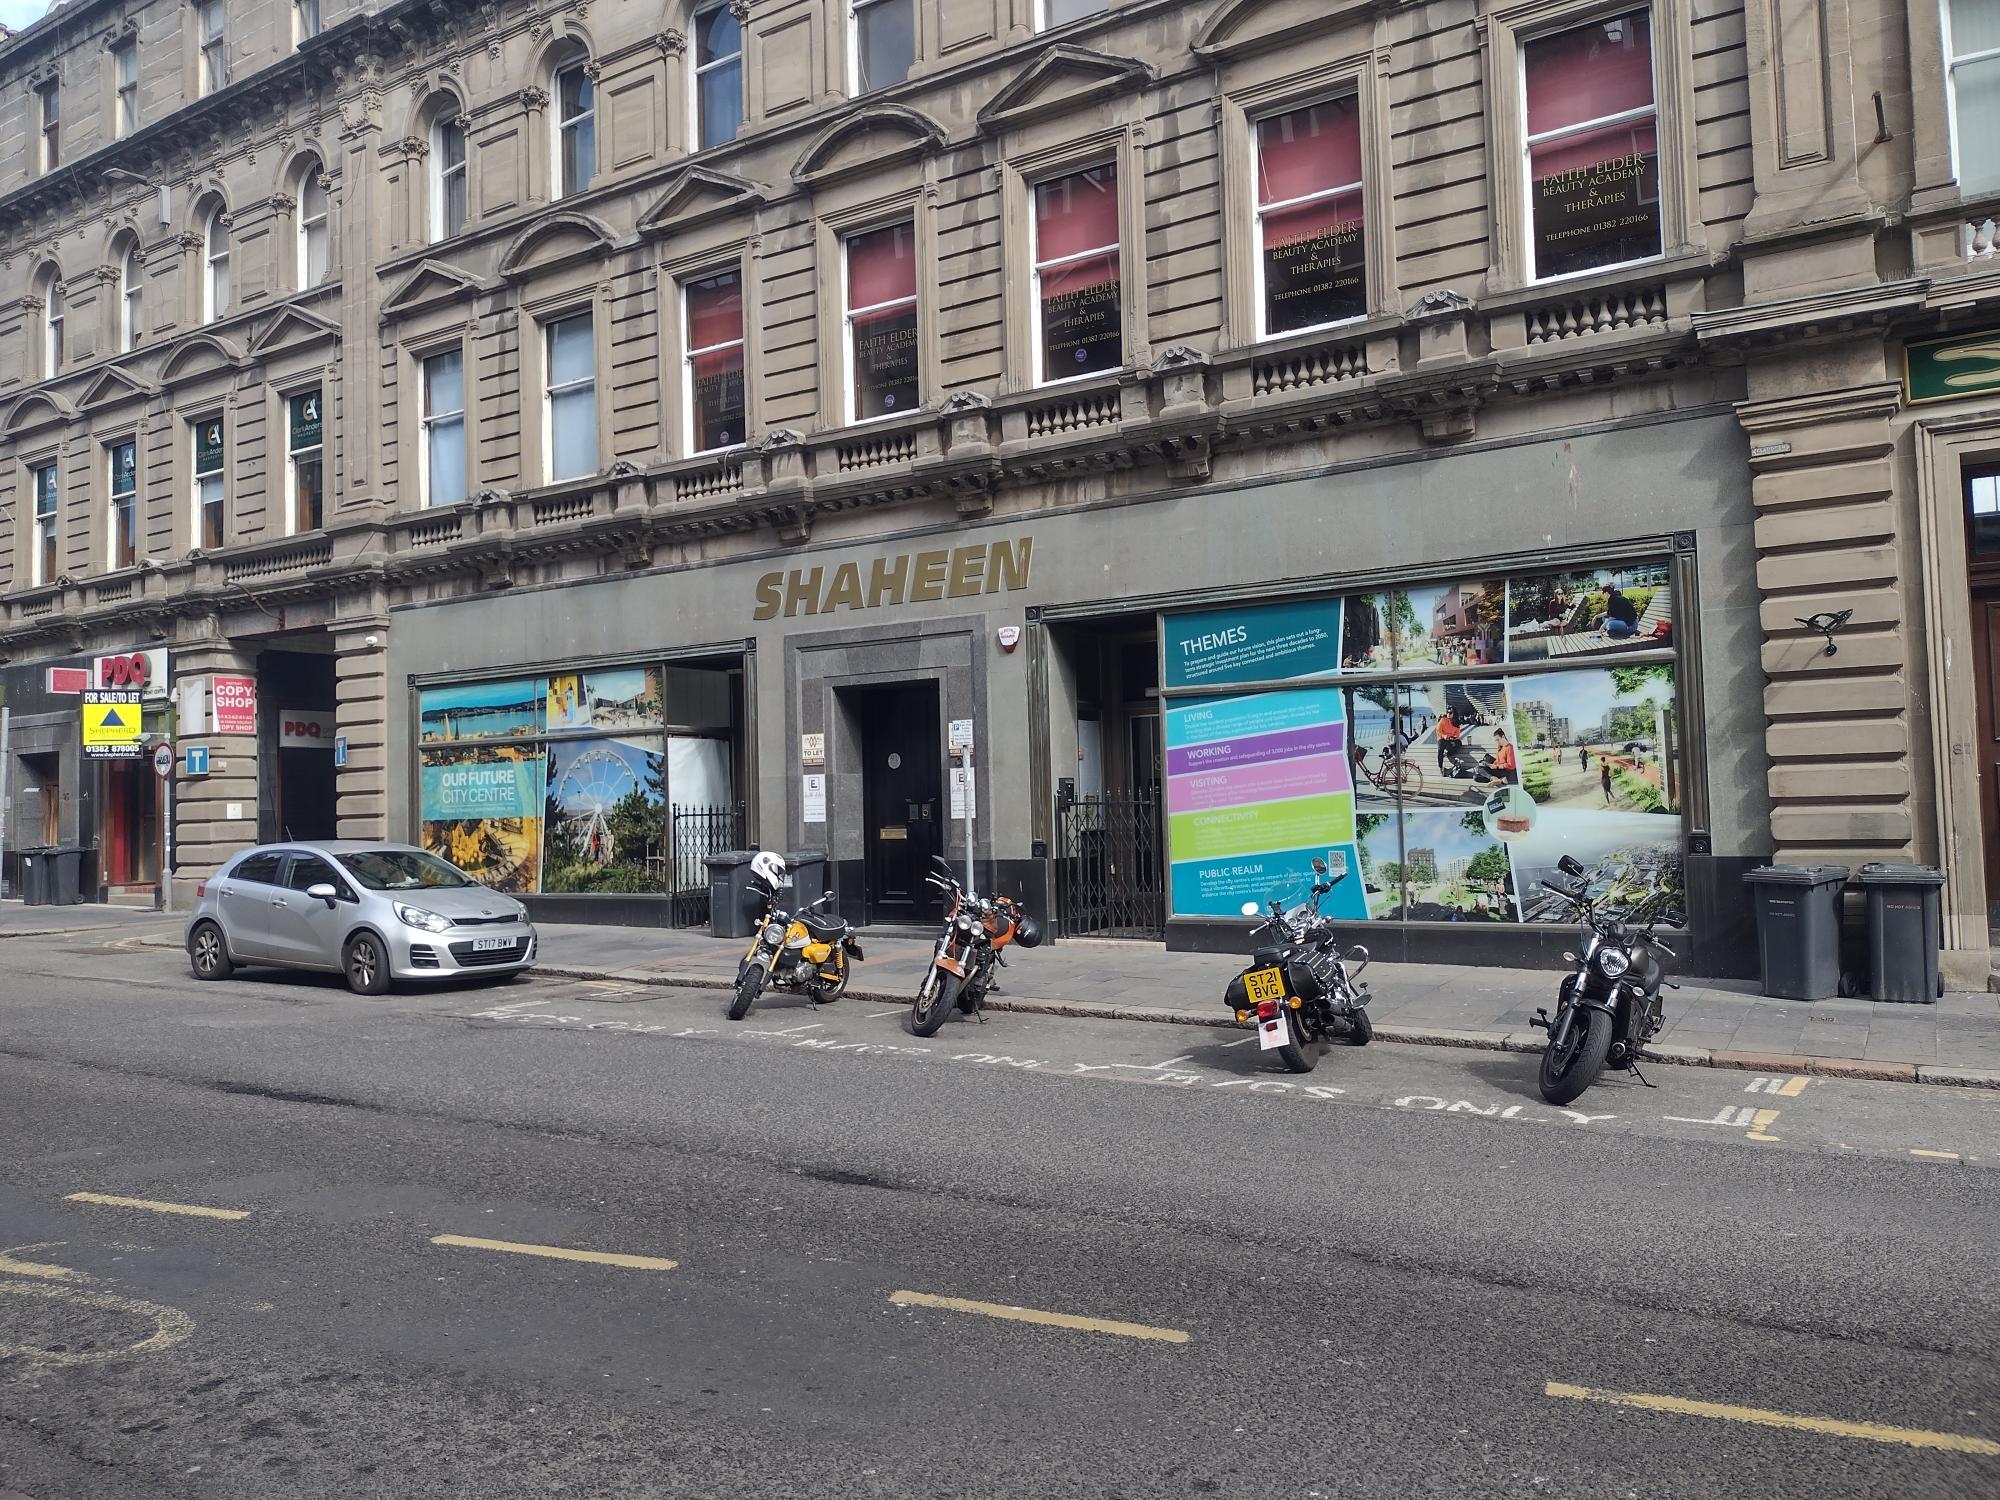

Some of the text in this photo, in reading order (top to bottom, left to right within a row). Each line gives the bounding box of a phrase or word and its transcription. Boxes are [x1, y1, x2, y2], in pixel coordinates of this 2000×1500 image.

[1543, 152, 1645, 187] FAITH ELDER
[1543, 165, 1646, 197] BEAUTY ACADEMY
[1589, 187, 1599, 197] &
[1564, 191, 1626, 213] THERAPIES
[1273, 220, 1357, 250] FAITH ELDER
[1545, 213, 1649, 242] TELEPHONE 01382 220166
[1273, 232, 1358, 260] BEAUTY ACADEMY
[1310, 251, 1319, 261] &
[1289, 256, 1342, 275] THERAPIES
[1048, 279, 1118, 305] FAITH ELDER
[1273, 275, 1359, 301] TELEPHONE 01382 220166
[1047, 290, 1119, 314] BEAUTY ACADEMY
[1079, 306, 1086, 315] &
[1063, 311, 1105, 328] THERAPIES
[859, 335, 886, 350] FAITH
[753, 536, 1035, 621] SHAHEEN
[1180, 625, 1248, 656] THEMES
[1207, 653, 1216, 661] and
[1216, 650, 1229, 660] guide
[1251, 641, 1267, 650] vision,
[1275, 636, 1286, 645] plan
[1195, 661, 1215, 671] strategic
[1239, 652, 1250, 661] plan
[1256, 647, 1265, 655] the
[1275, 642, 1289, 650] three
[1288, 637, 1309, 647] decades
[1241, 654, 1265, 666] connected
[1265, 652, 1274, 660] and
[102, 652, 147, 687] PDQ
[84, 692, 99, 704] FOR
[99, 692, 127, 704] SALE/TO
[128, 692, 140, 704] LET
[216, 684, 253, 697] COPY
[216, 696, 254, 708] SHOP
[1184, 710, 1213, 723] LIVING
[89, 727, 136, 735] SHEPHERD
[284, 720, 321, 738] PDQ
[85, 744, 140, 753] 01382 878005
[1187, 744, 1232, 759] WORKING
[442, 769, 515, 787] OUR FUTURE
[1190, 775, 1228, 789] VISITING
[442, 786, 515, 804] CITY CENTRE
[1193, 809, 1260, 827] CONNECTIVITY
[1199, 863, 1263, 879] PUBLIC REALM
[478, 939, 496, 949] ST17
[1249, 970, 1277, 987] ST21
[1254, 983, 1279, 999] BVG
[1394, 1094, 1618, 1126] ONLY
